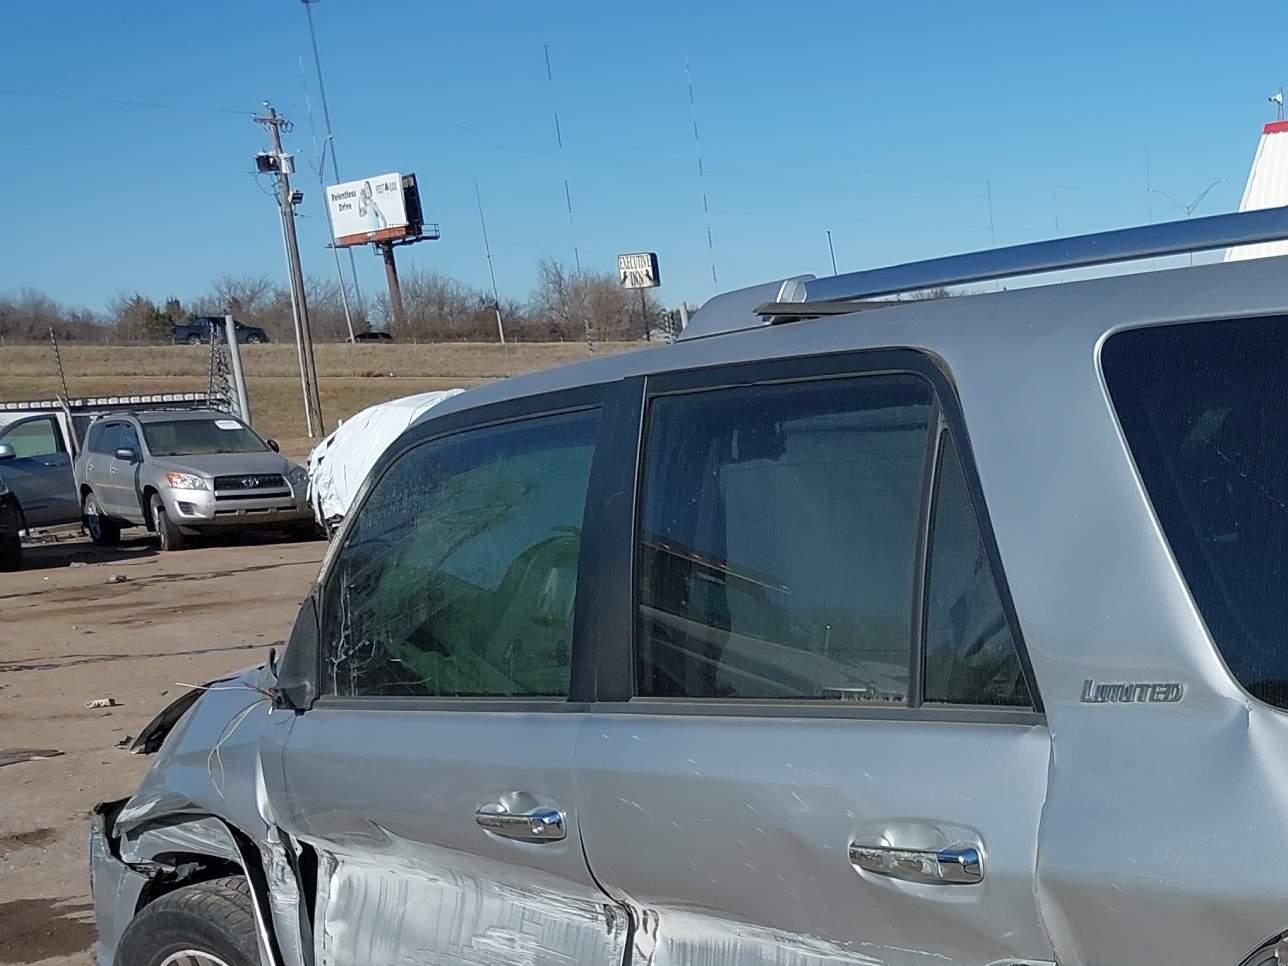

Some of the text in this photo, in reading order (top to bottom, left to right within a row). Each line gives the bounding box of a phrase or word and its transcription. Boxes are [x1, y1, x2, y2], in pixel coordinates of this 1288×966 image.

[331, 190, 357, 201] Relentless
[338, 202, 353, 213] Drive
[619, 255, 650, 270] EXECUTIVE
[630, 270, 645, 288] INN
[1080, 679, 1184, 703] LIMITED
